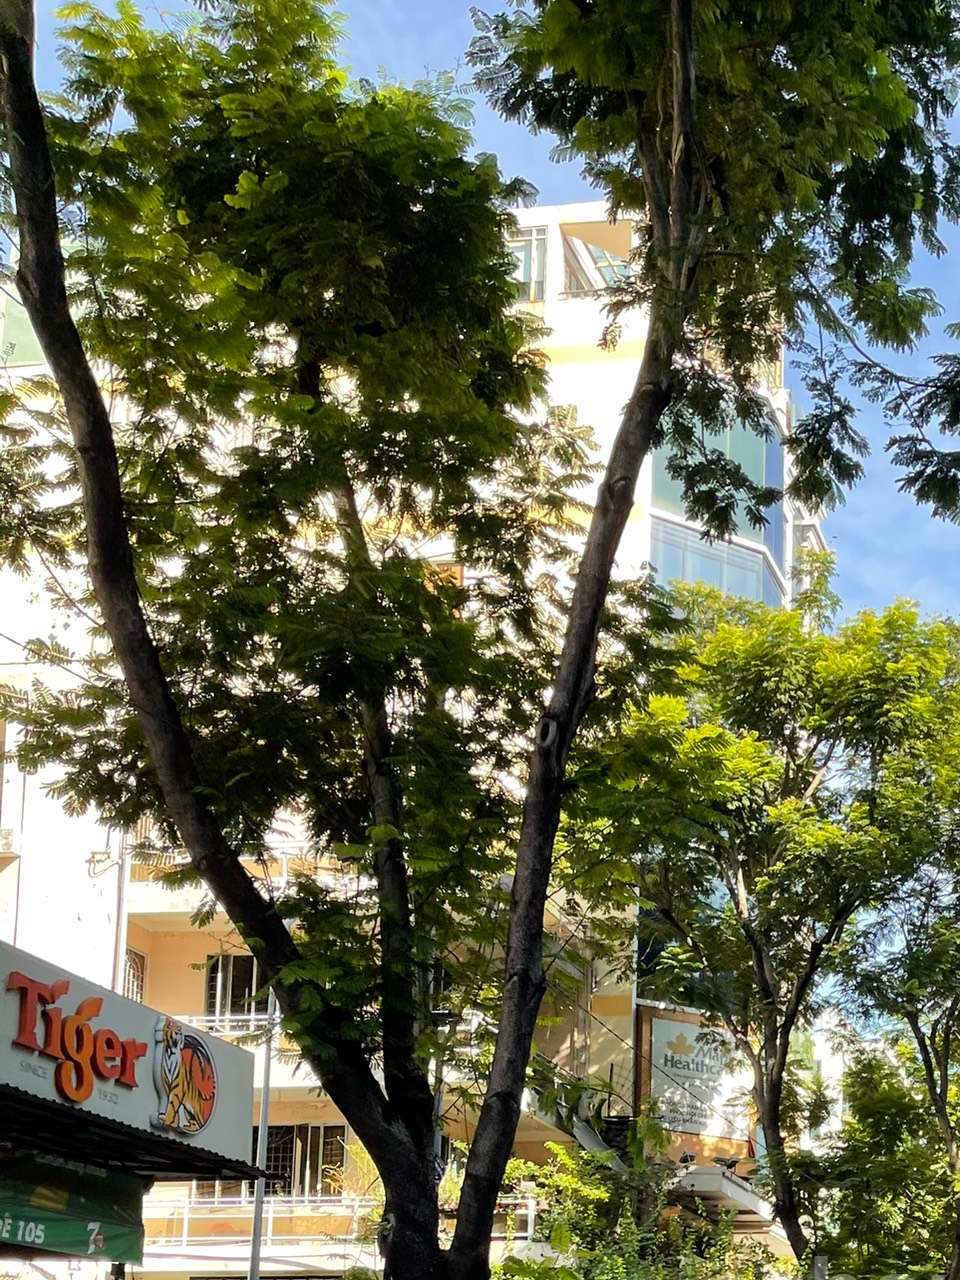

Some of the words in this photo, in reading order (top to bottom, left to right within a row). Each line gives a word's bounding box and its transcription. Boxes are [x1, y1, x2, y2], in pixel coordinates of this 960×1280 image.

[6, 970, 149, 1104] Tiger
[663, 1053, 724, 1077] Healthca
[17, 1220, 46, 1245] 105
